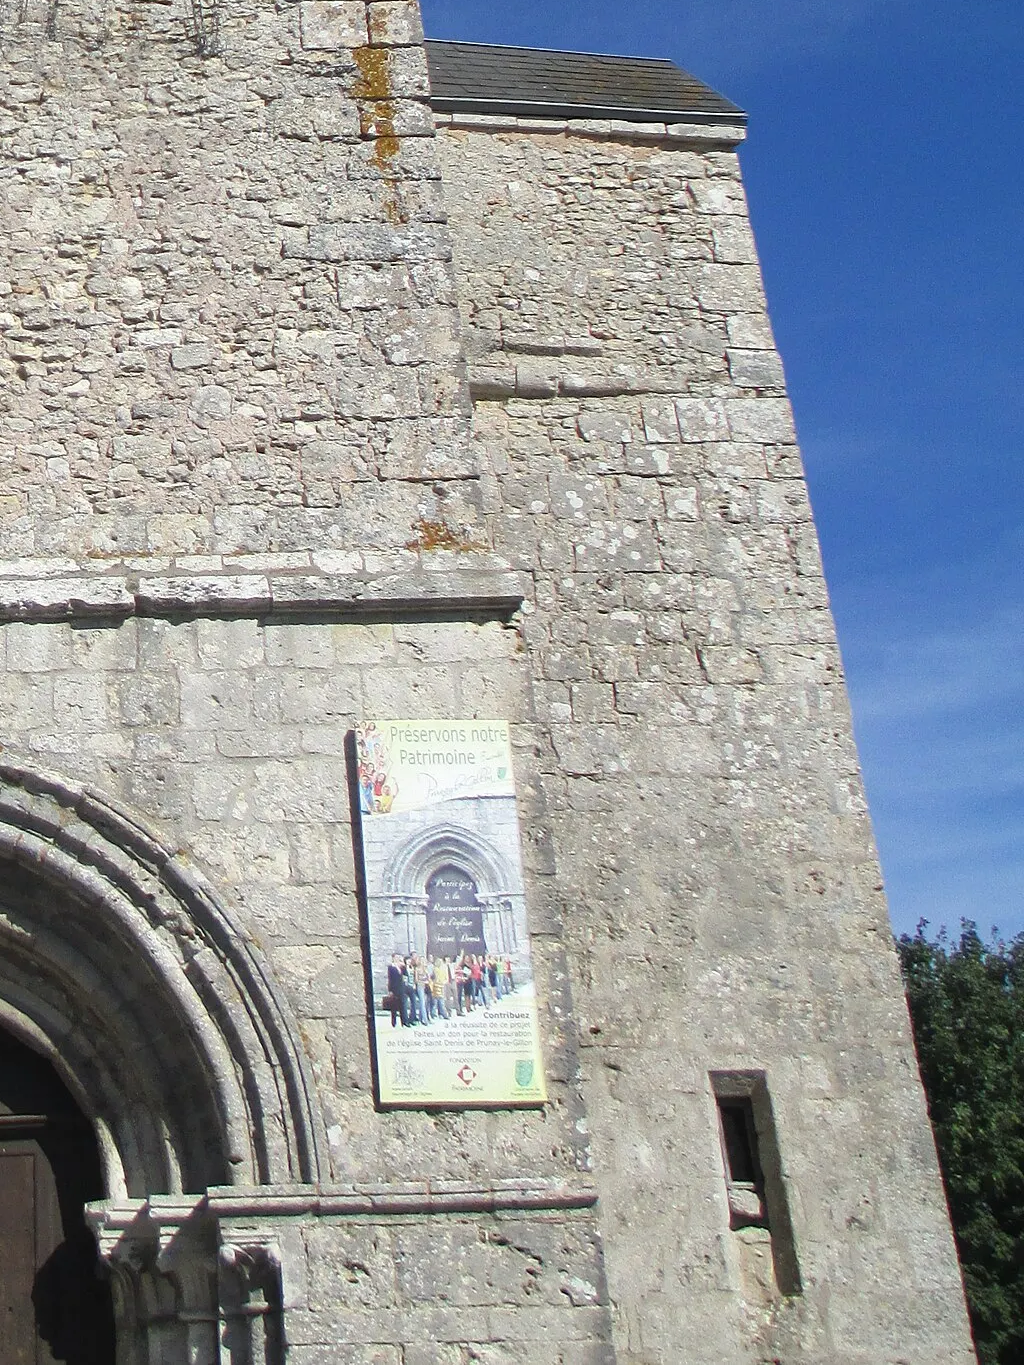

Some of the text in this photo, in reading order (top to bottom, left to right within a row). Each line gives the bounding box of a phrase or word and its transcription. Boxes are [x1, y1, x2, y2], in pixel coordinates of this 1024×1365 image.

[390, 724, 508, 743] Préservons notre
[400, 749, 476, 765] Patrimoine
[435, 878, 475, 890] Participez
[483, 1011, 530, 1019] Contribuez
[510, 1021, 531, 1030] projet
[423, 1039, 442, 1047] Saint
[444, 1039, 463, 1047] Denis
[465, 1039, 475, 1047] de
